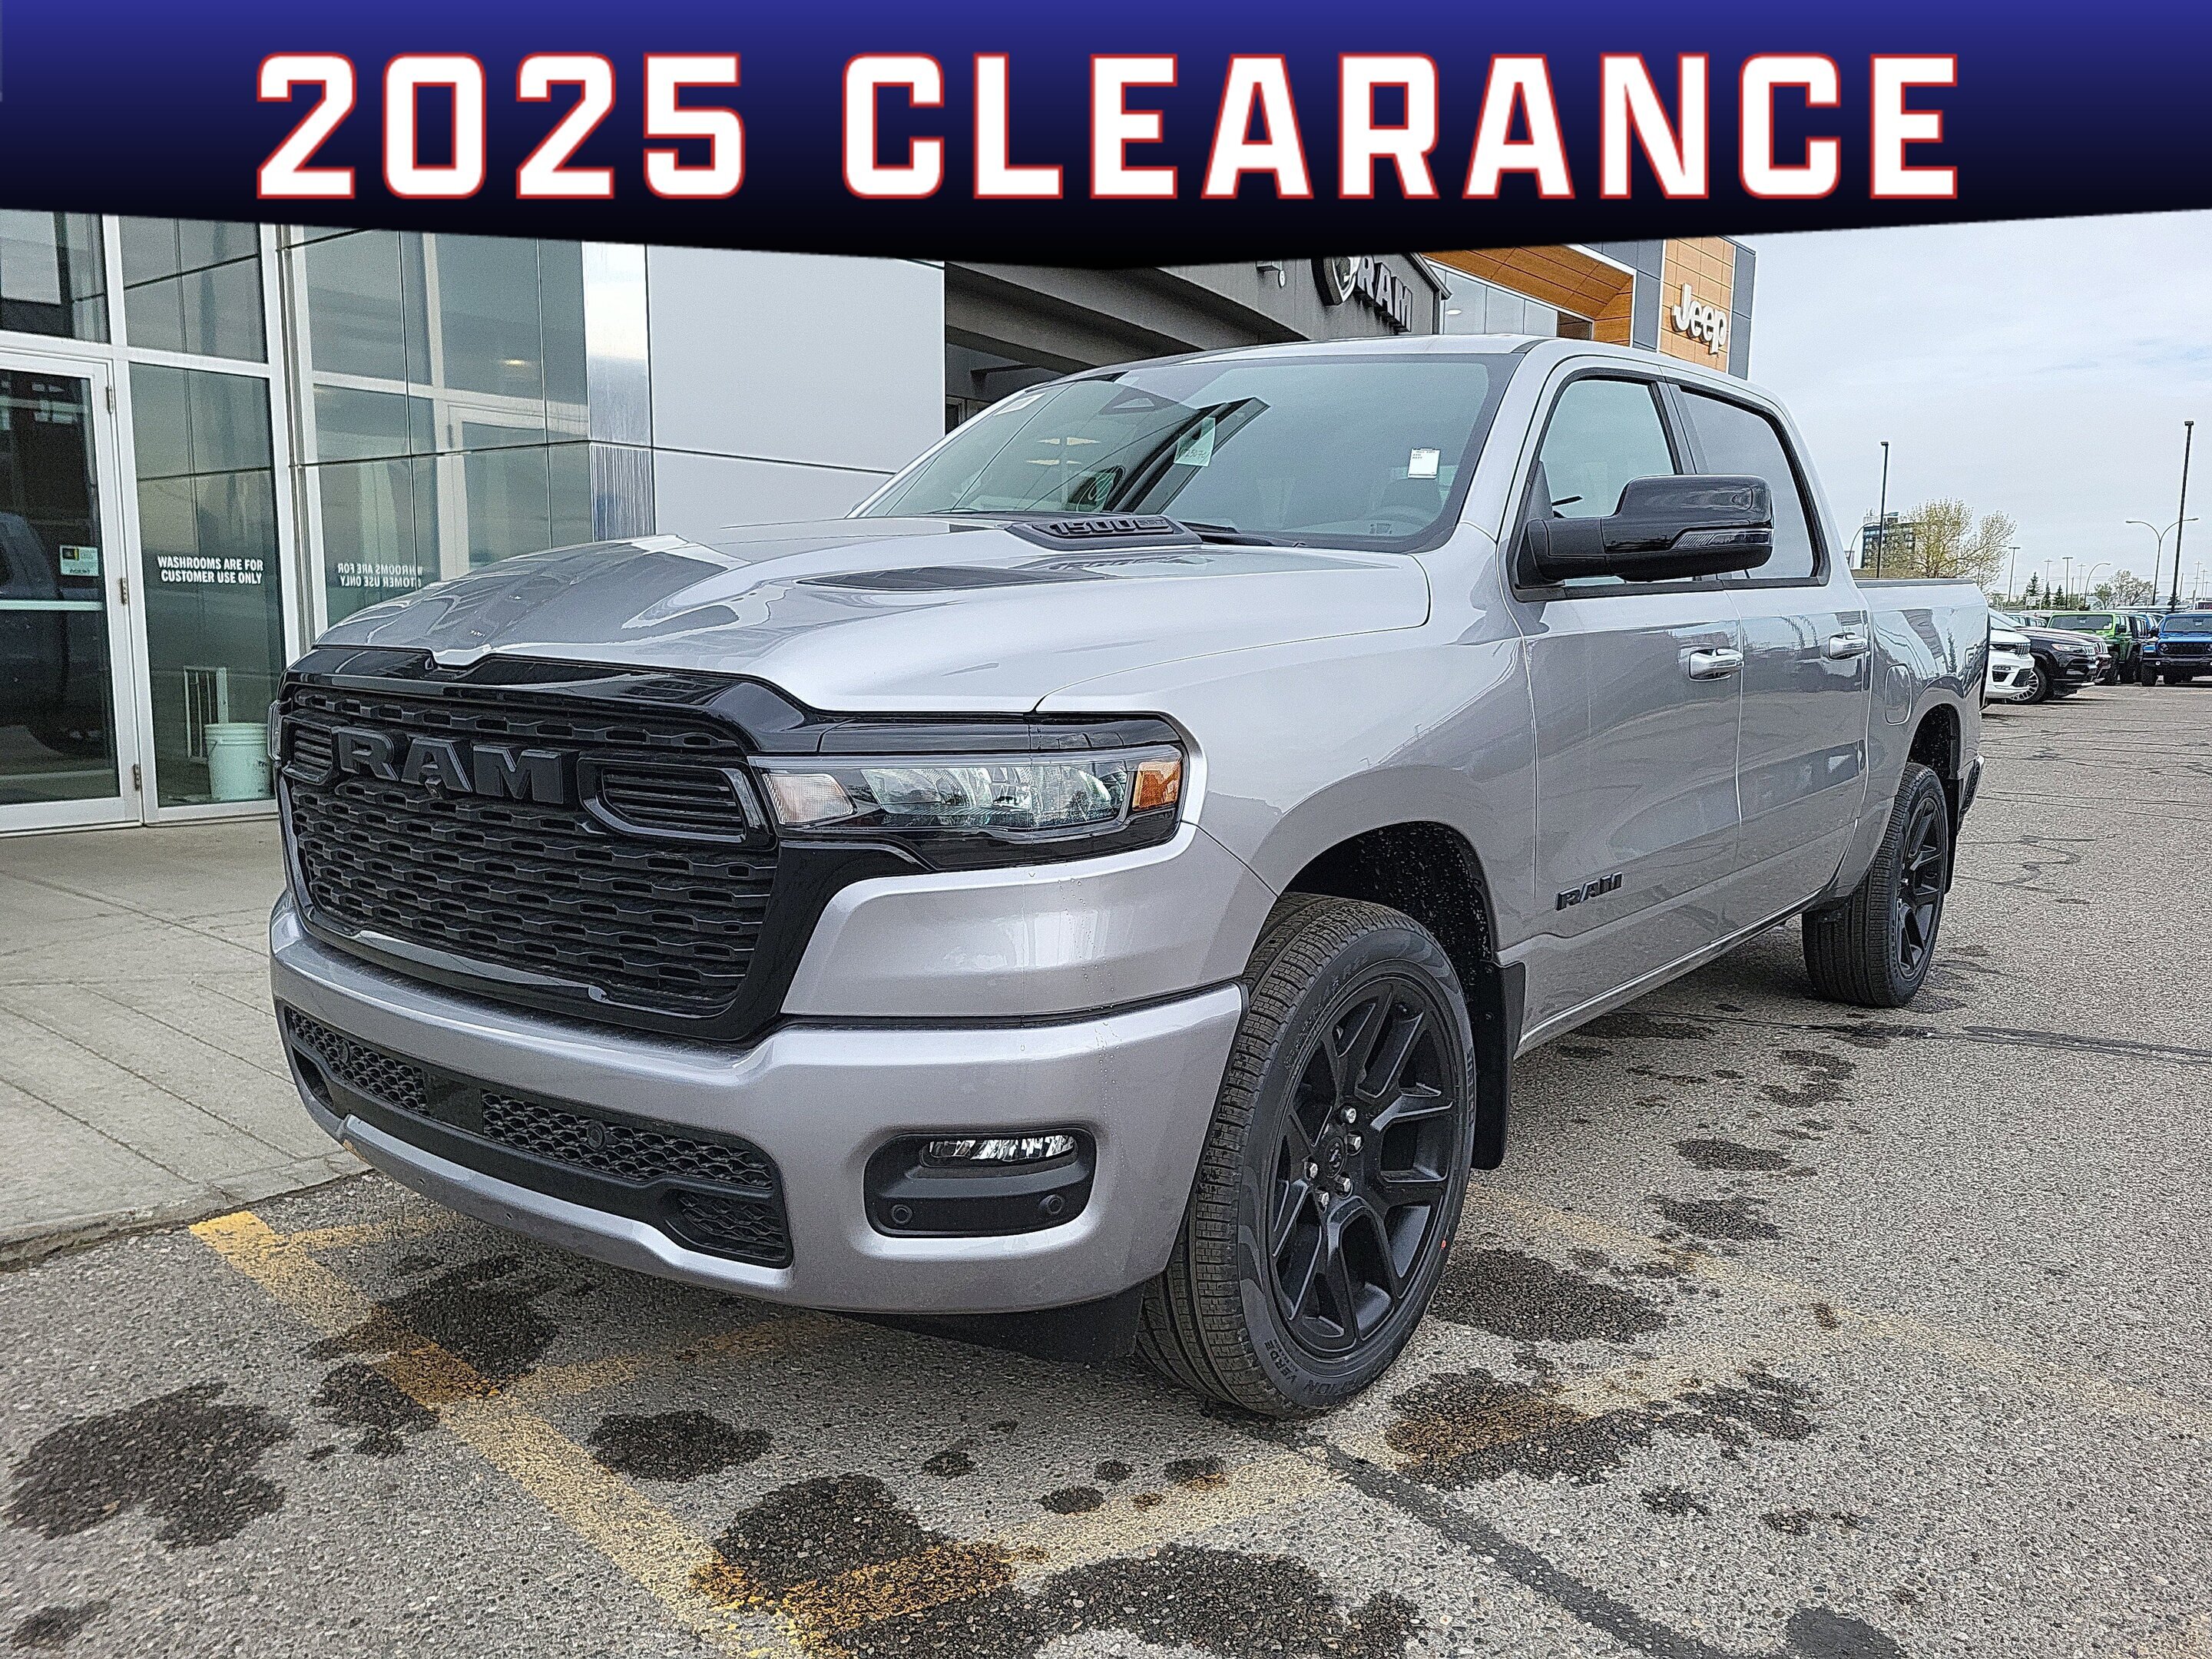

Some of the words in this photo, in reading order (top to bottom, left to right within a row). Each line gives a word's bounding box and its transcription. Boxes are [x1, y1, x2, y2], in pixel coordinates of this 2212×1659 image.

[1356, 254, 1412, 332] RAM
[1671, 283, 1727, 354] Jeep
[1049, 519, 1137, 535] 1500
[157, 555, 221, 570] WASHROOMS
[224, 558, 243, 571] ARE
[244, 558, 263, 571] FOR
[161, 569, 215, 583] CUSTOMER
[217, 571, 236, 584] USE
[237, 571, 262, 584] ONLY
[332, 726, 564, 804] RAM
[1555, 871, 1623, 911] RAM
[1264, 1339, 1297, 1382] VERDE
